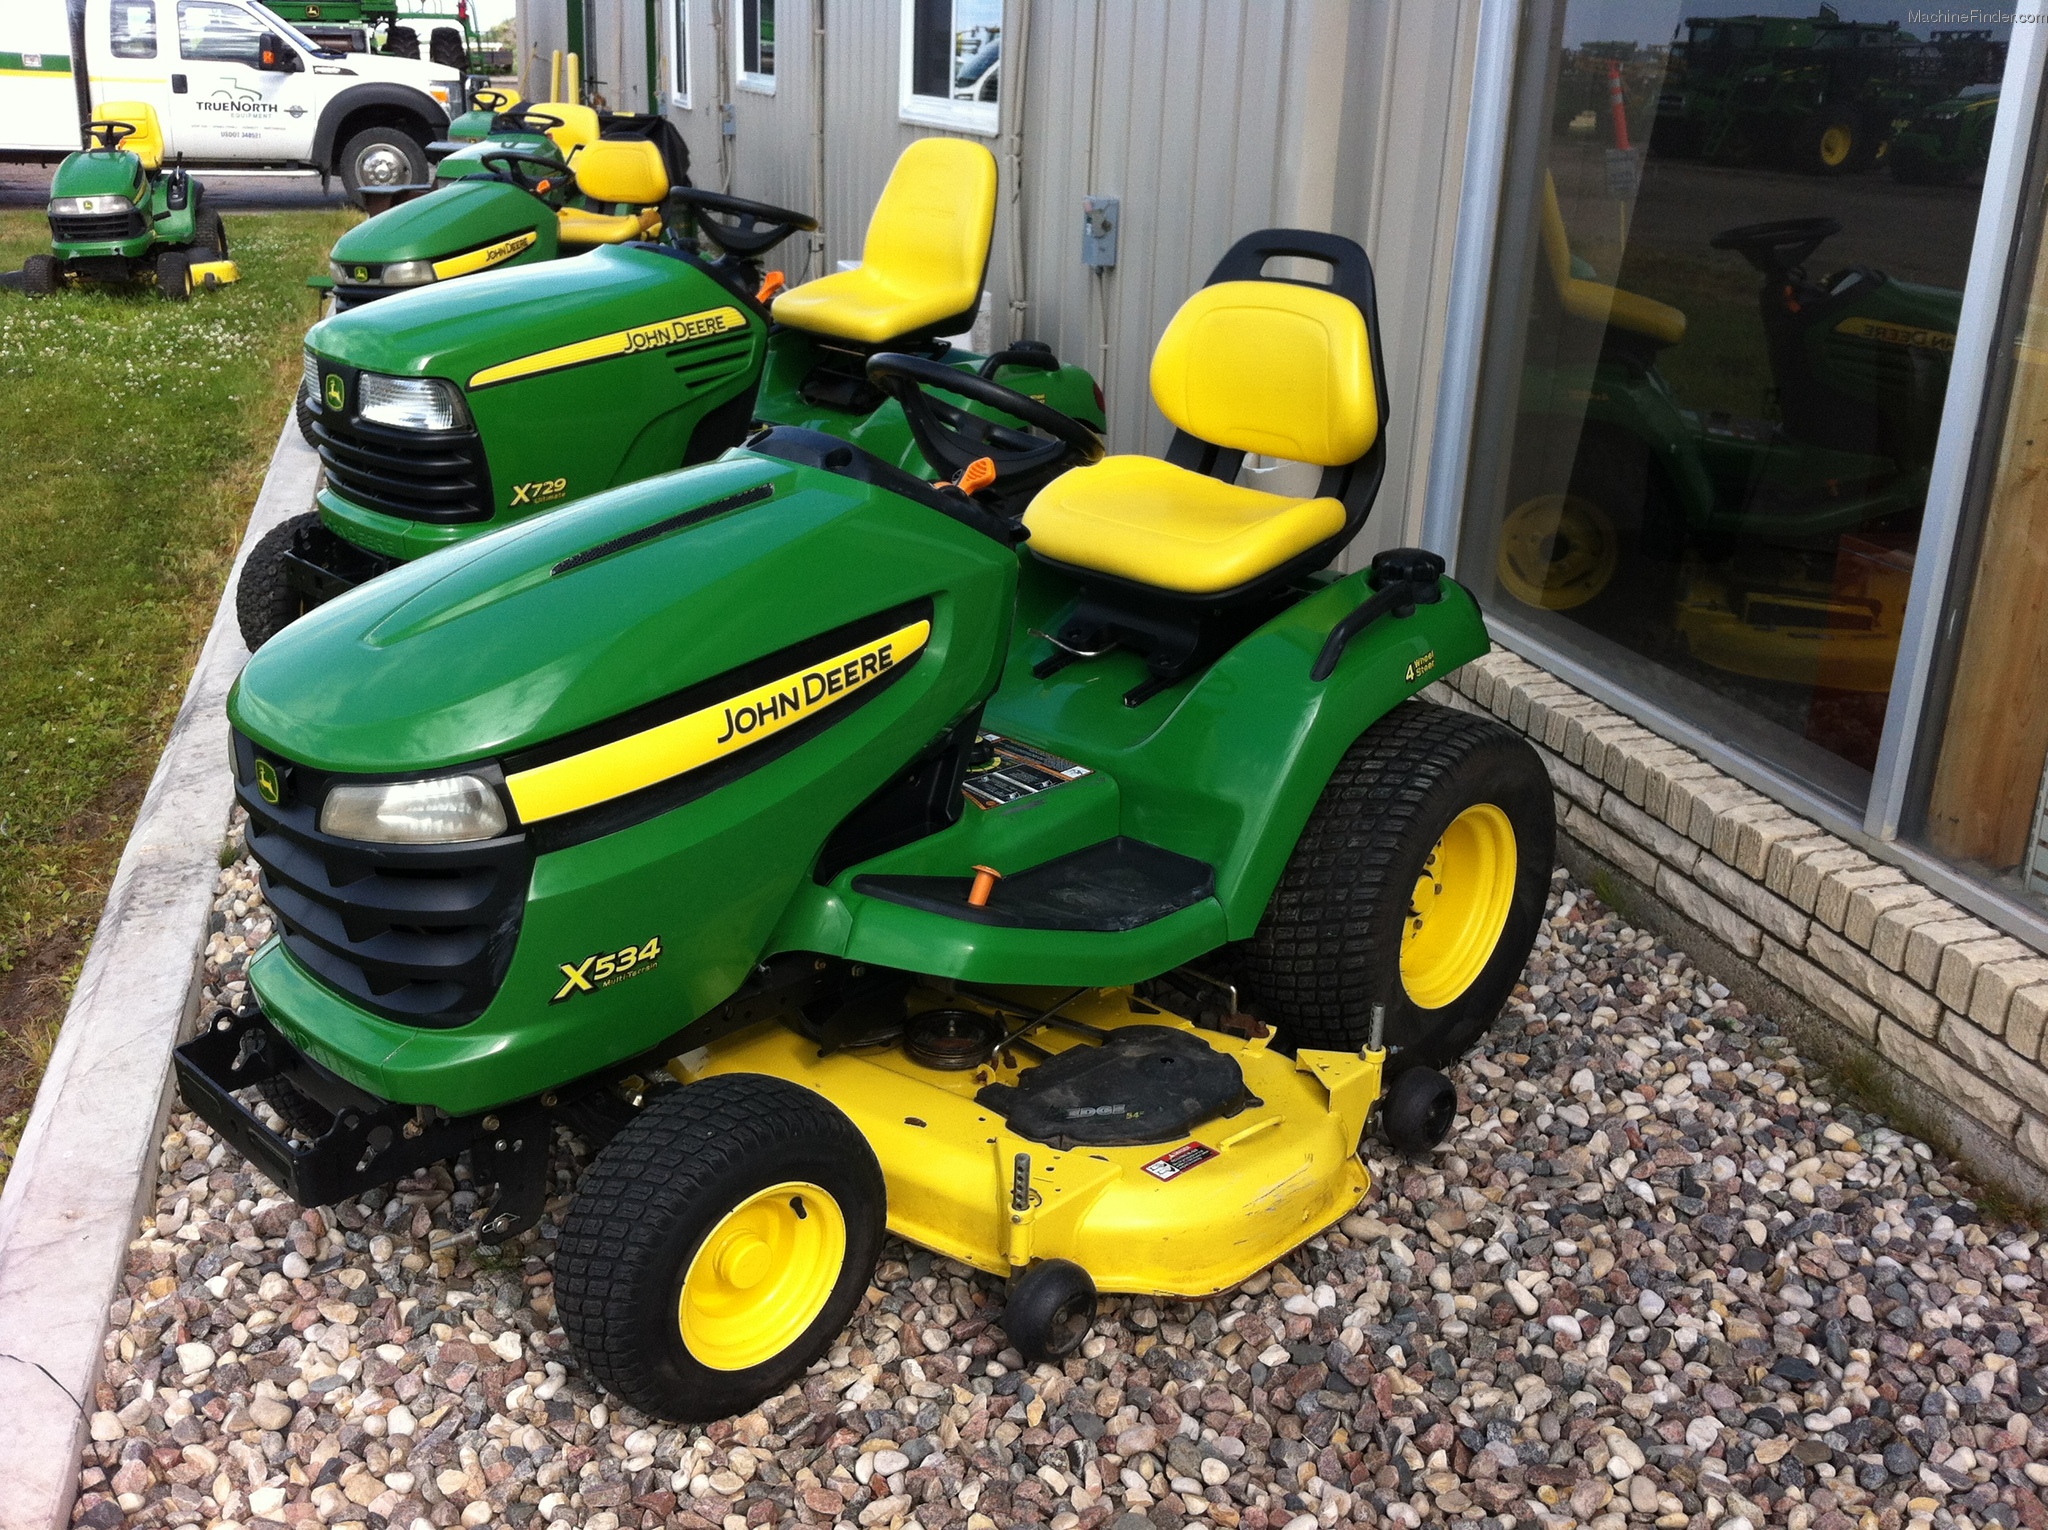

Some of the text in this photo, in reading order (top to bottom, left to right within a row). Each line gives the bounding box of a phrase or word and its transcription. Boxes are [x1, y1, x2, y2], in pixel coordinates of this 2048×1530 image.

[196, 101, 278, 112] TRUENORTH
[486, 237, 529, 262] JOHN DEERE
[624, 315, 727, 352] JOHN DEERE
[509, 477, 567, 507] X729
[1405, 664, 1415, 681] 4
[717, 643, 894, 744] JOHN DEERE
[549, 935, 662, 1003] X534
[602, 962, 658, 988] Multi-Terrain
